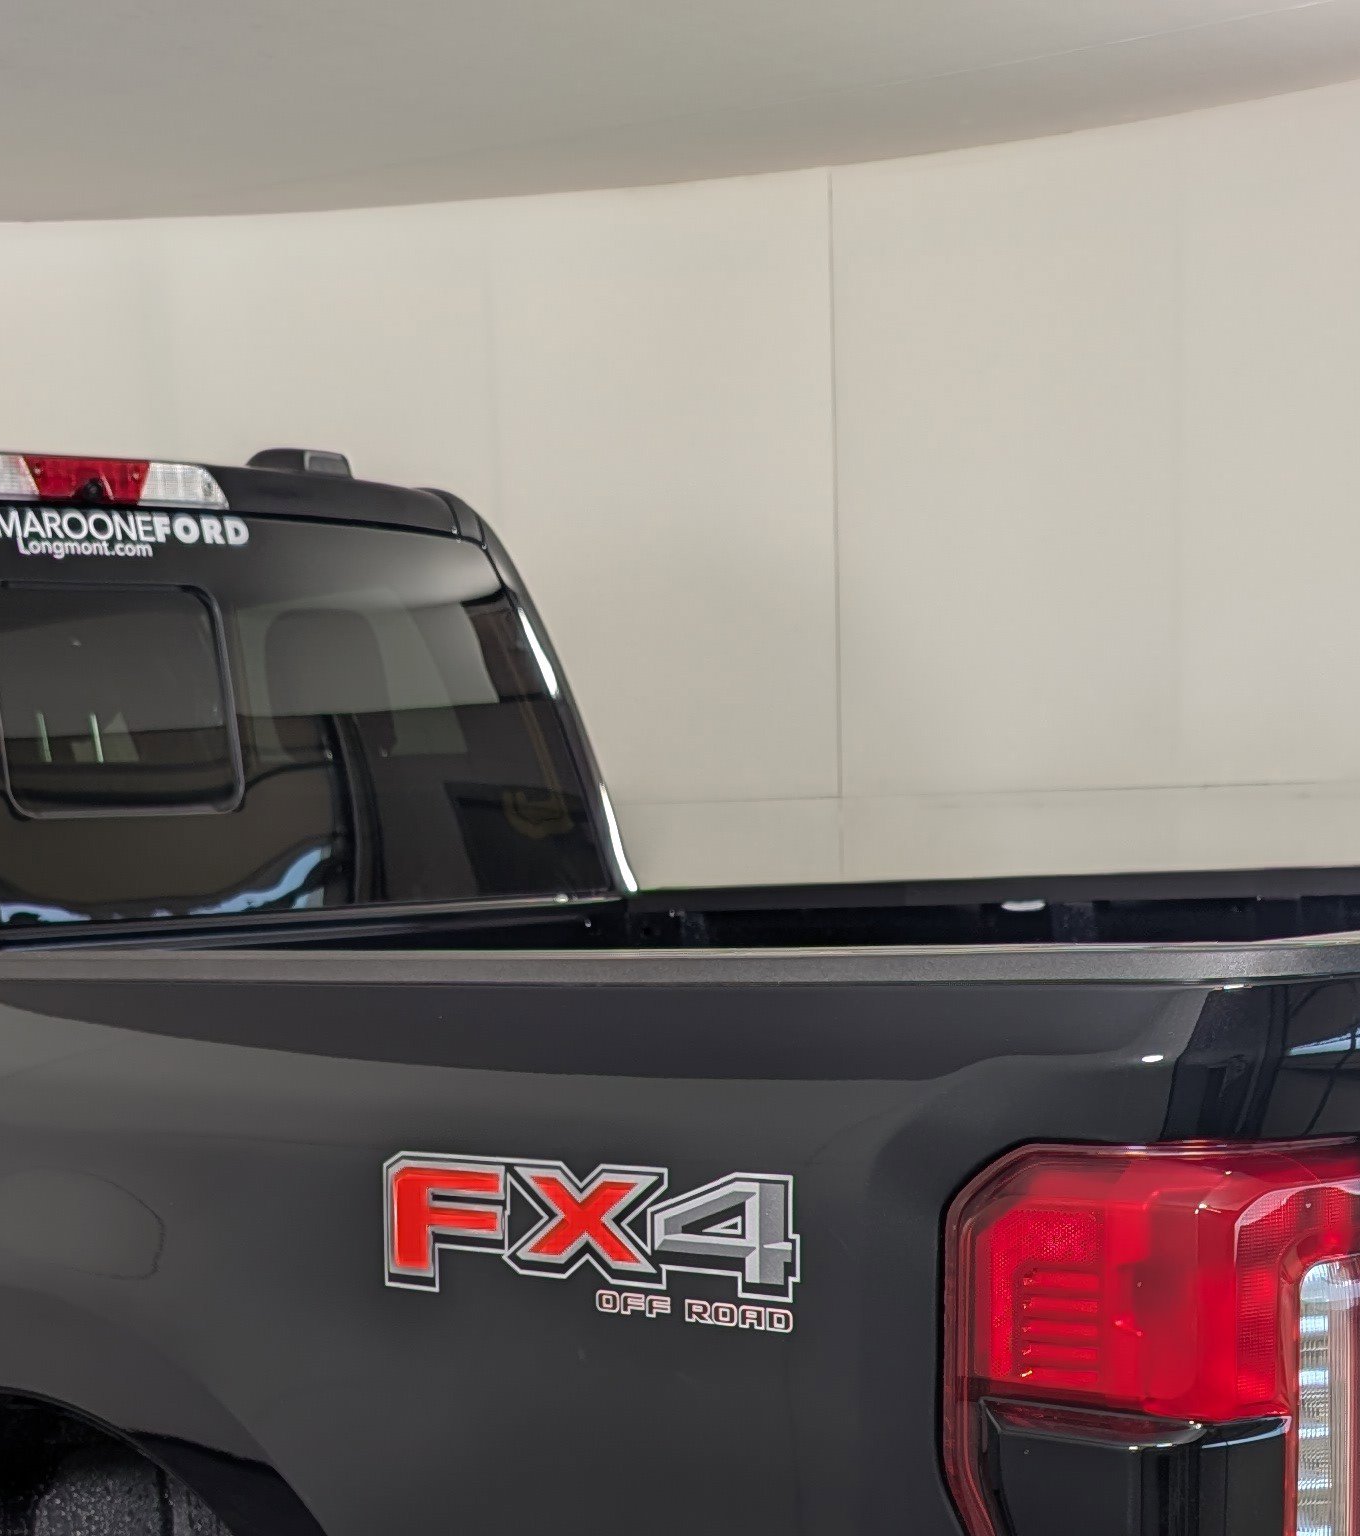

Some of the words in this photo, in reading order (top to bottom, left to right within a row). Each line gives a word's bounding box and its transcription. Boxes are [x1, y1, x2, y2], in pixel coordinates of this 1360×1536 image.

[17, 534, 153, 559] Longmont.com
[383, 1151, 800, 1303] FX4
[595, 1289, 671, 1318] OFF
[685, 1298, 794, 1333] ROAD
